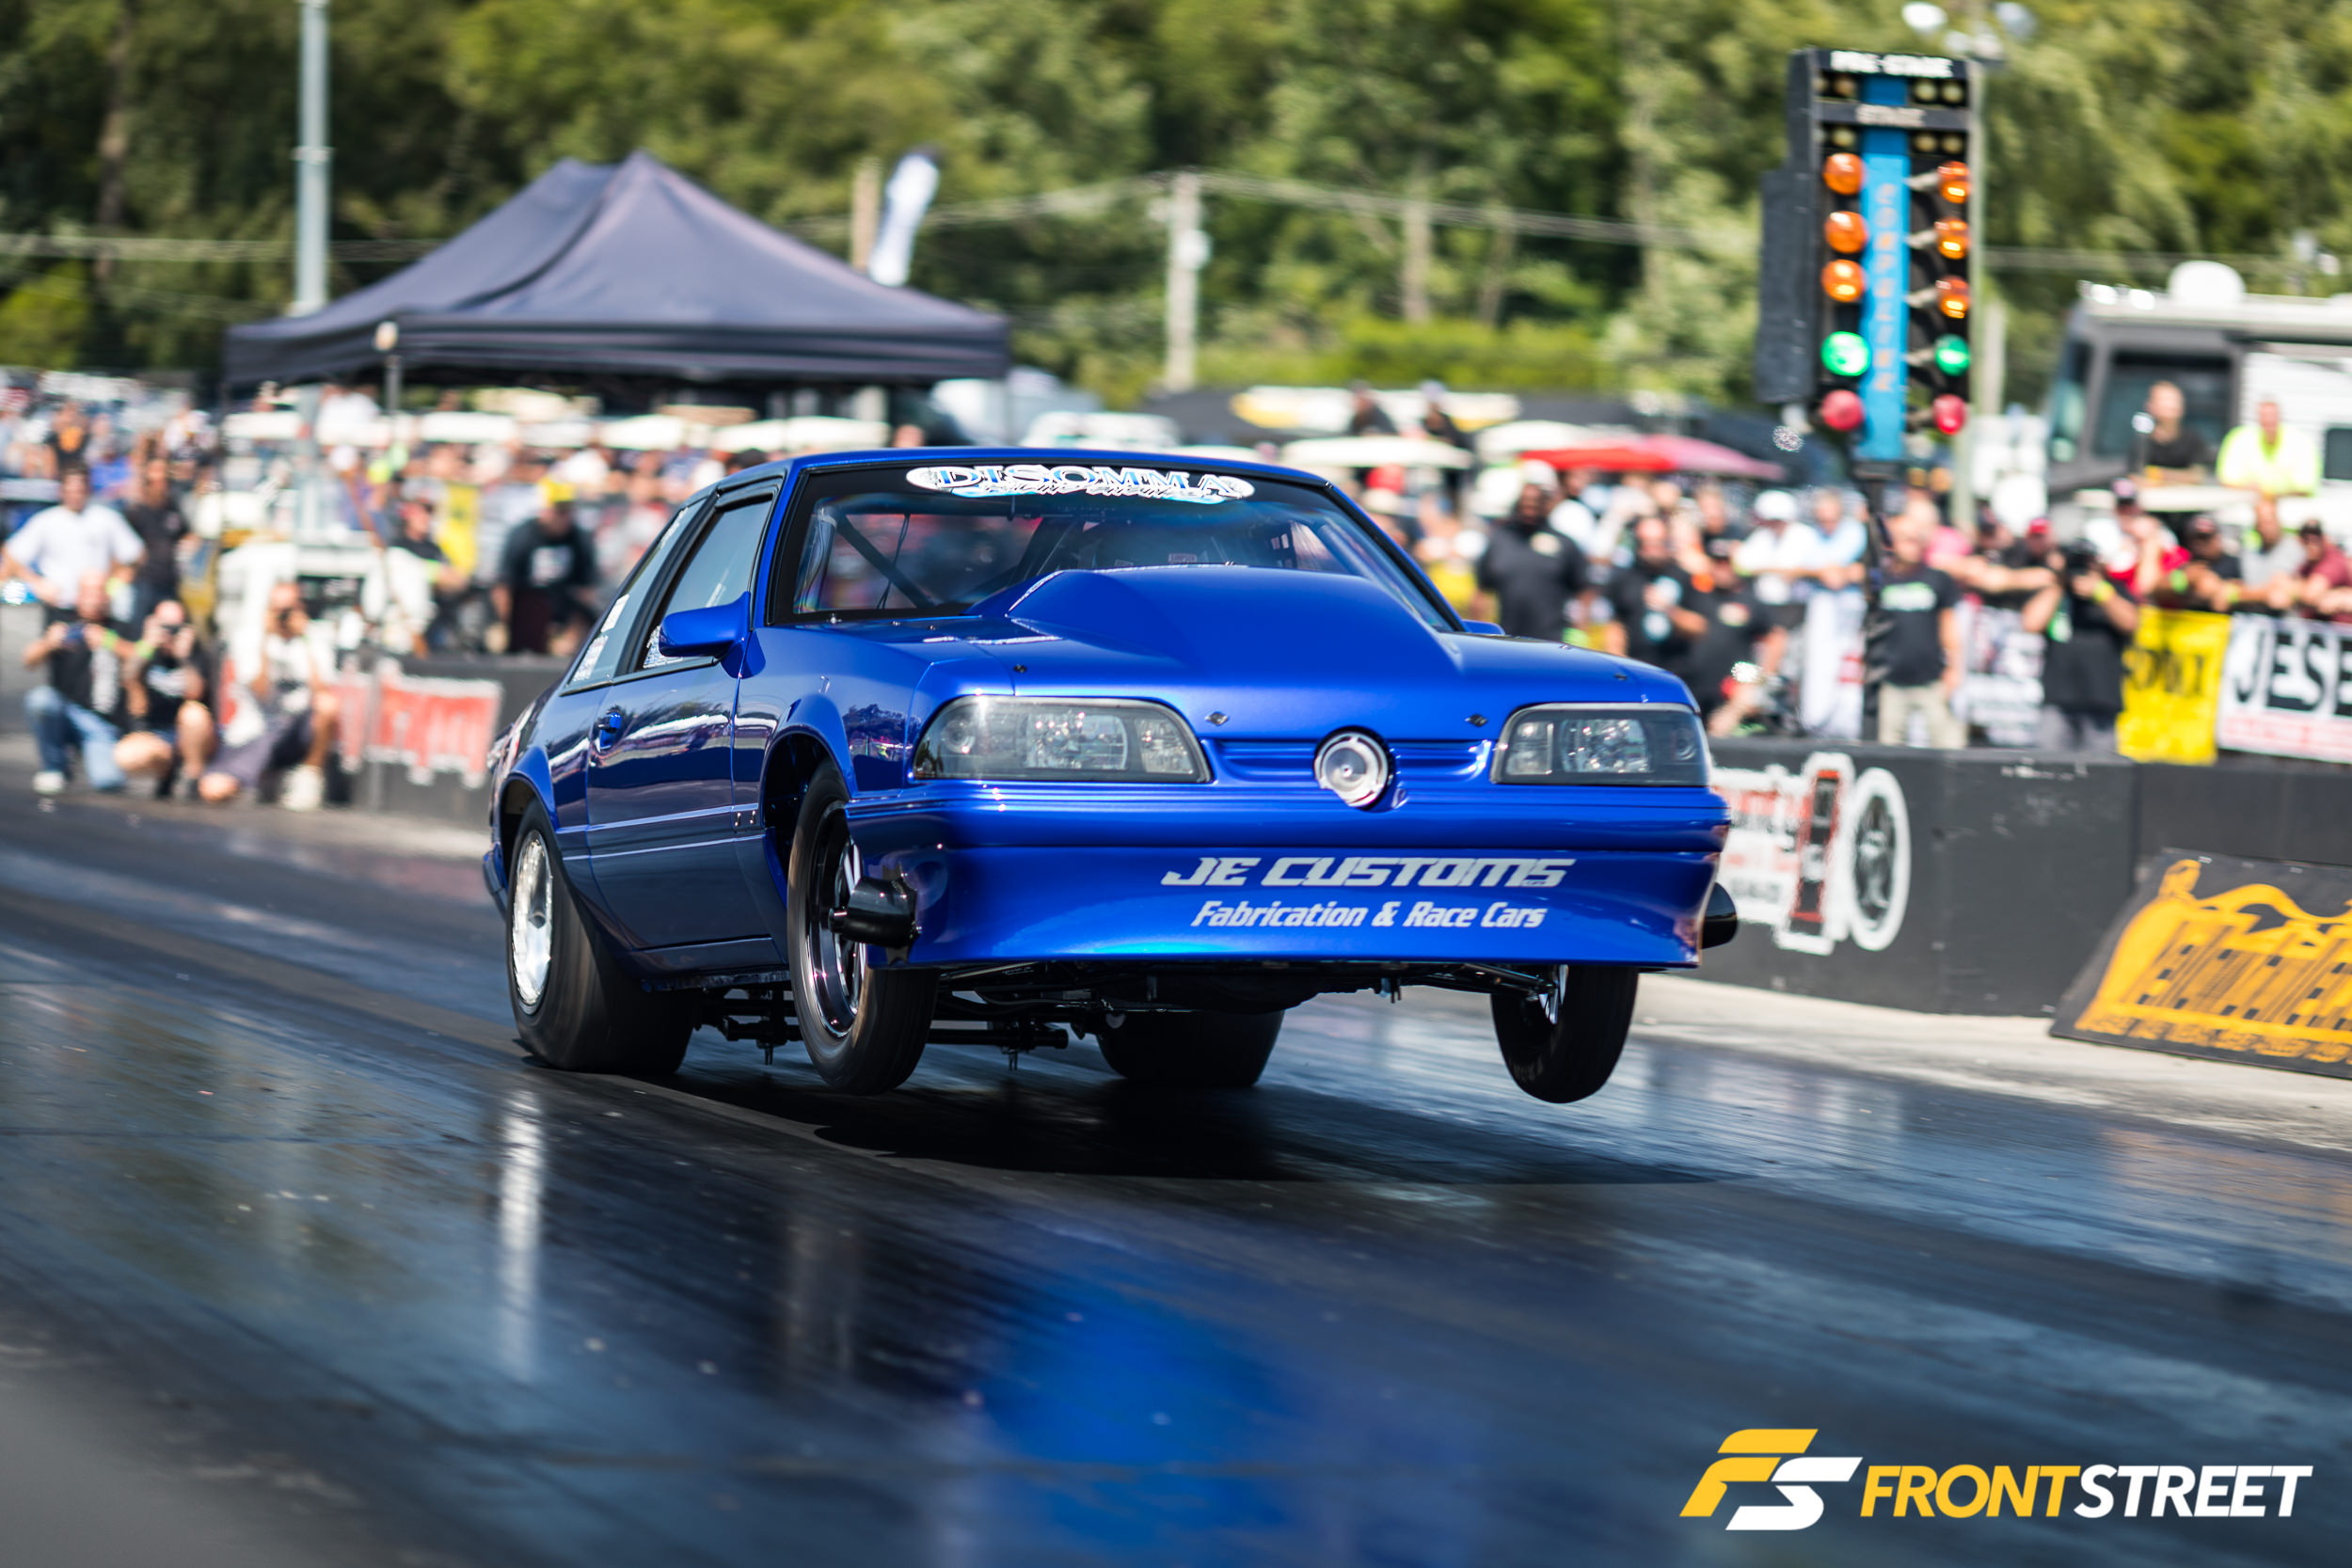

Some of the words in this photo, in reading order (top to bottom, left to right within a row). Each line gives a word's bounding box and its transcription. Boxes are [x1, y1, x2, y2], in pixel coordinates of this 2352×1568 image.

[938, 465, 1242, 498] DISOMMA
[1161, 857, 1262, 886] JE
[1261, 857, 1577, 887] CUSTOMS
[1190, 900, 1369, 927] Fabrication
[1371, 901, 1402, 927] &
[1402, 901, 1477, 927] Race
[1480, 901, 1548, 928] Cars
